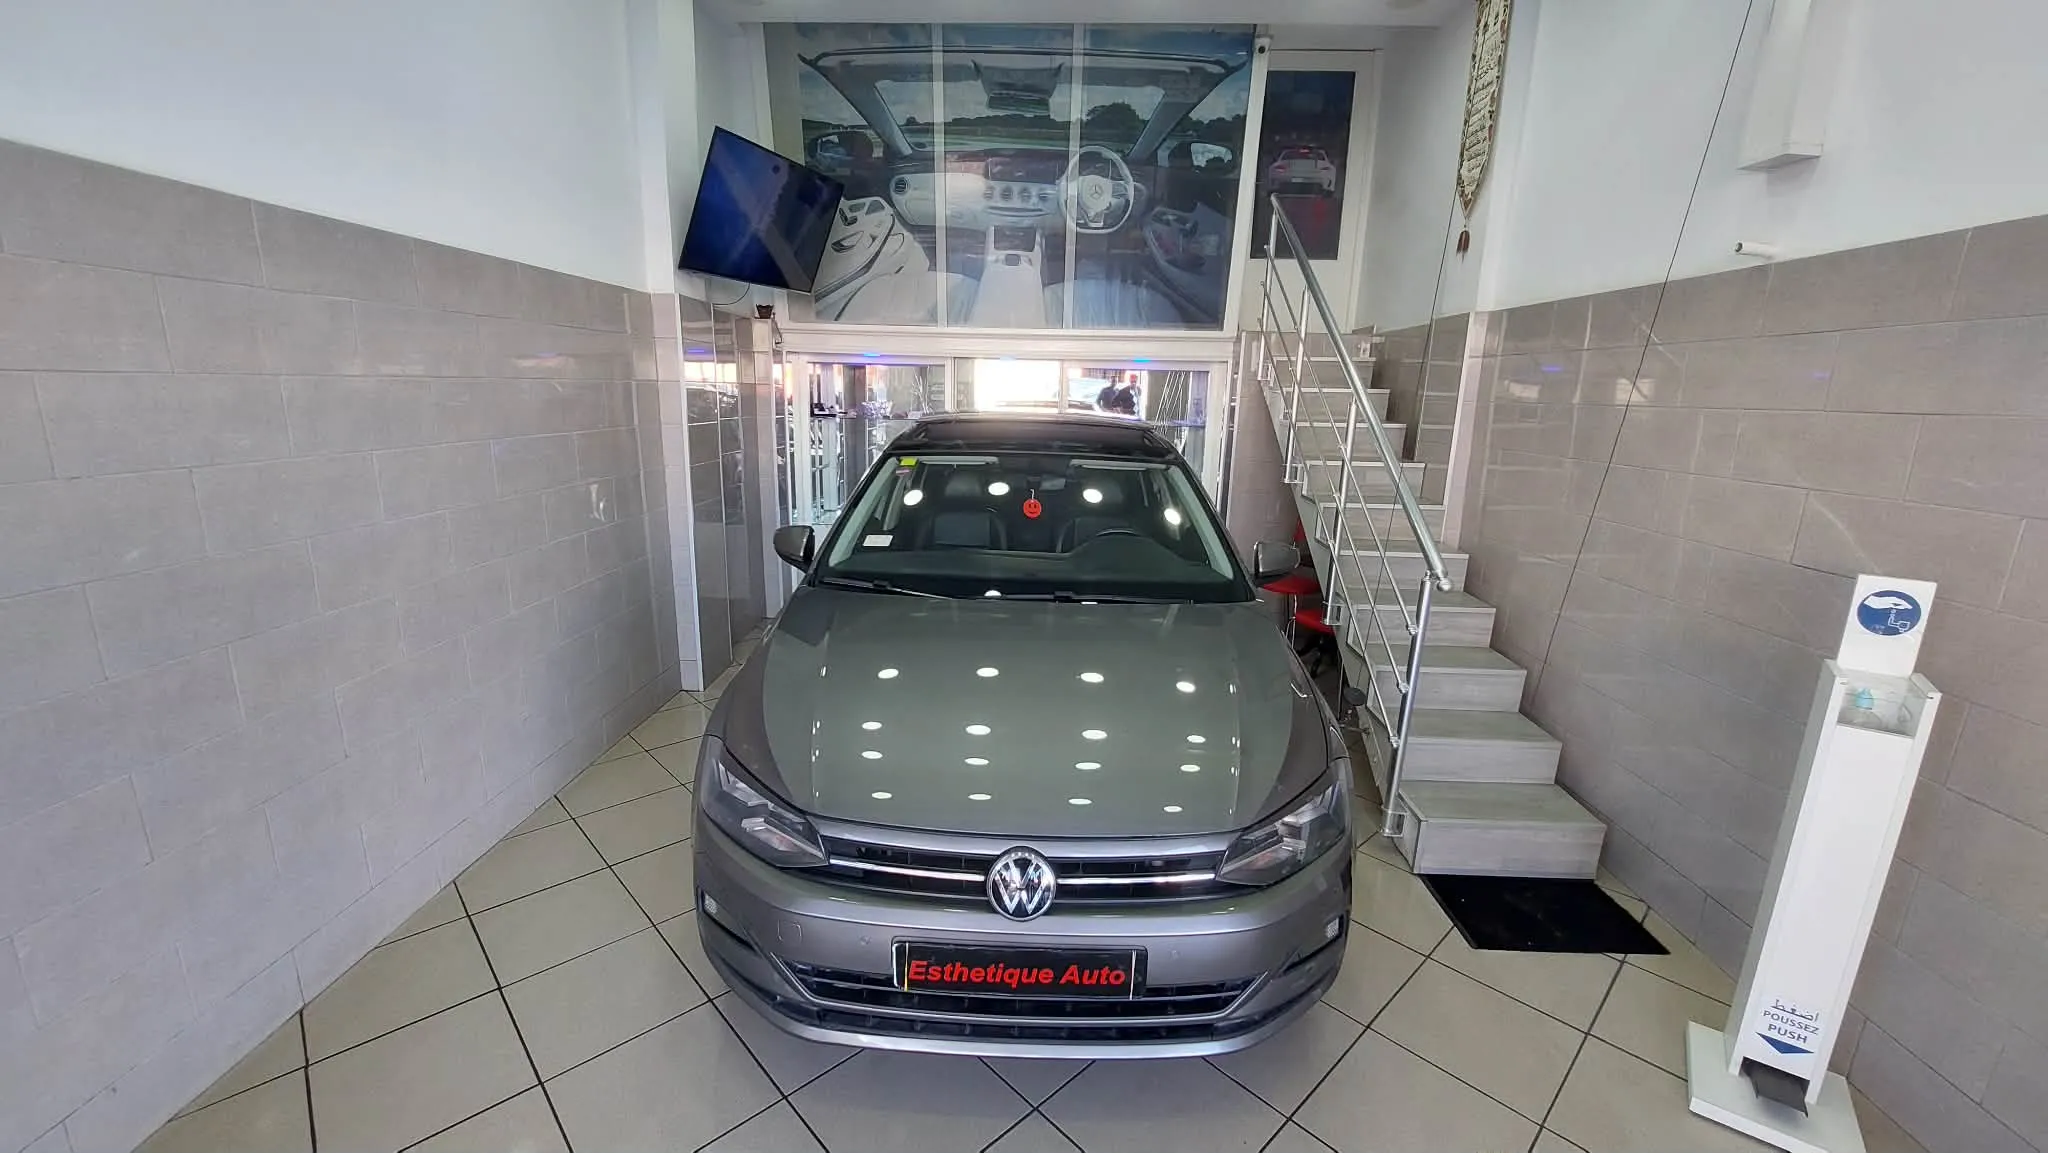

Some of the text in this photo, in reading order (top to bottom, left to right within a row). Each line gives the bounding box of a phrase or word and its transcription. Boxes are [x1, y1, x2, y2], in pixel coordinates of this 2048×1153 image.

[909, 960, 1126, 988] Esthetique Auto
[1763, 1010, 1819, 1035] POUSSEZ
[1770, 999, 1819, 1022] اضغط
[1768, 1024, 1807, 1043] PUSH
